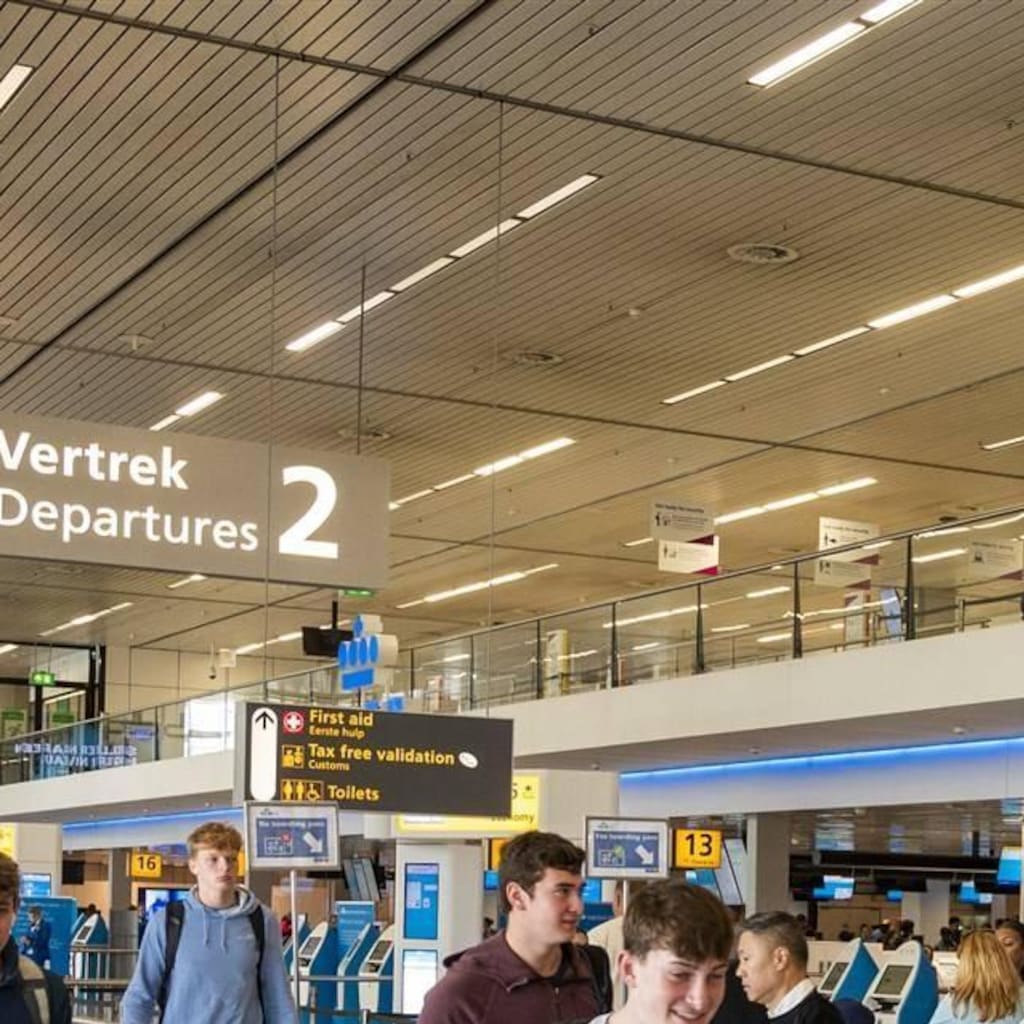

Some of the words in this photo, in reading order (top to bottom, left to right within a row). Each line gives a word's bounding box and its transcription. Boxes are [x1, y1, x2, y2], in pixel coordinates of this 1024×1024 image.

[0, 429, 189, 490] Vertrek
[0, 487, 259, 552] Departures
[278, 465, 339, 559] 2
[308, 709, 345, 725] First
[349, 711, 374, 727] aid
[343, 728, 365, 739] hulp
[308, 743, 335, 759] Tax
[340, 745, 372, 761] free
[376, 747, 455, 766] validation
[308, 759, 350, 771] Customs
[327, 786, 380, 801] Toilets
[685, 833, 713, 857] 13
[137, 856, 156, 871] 16
